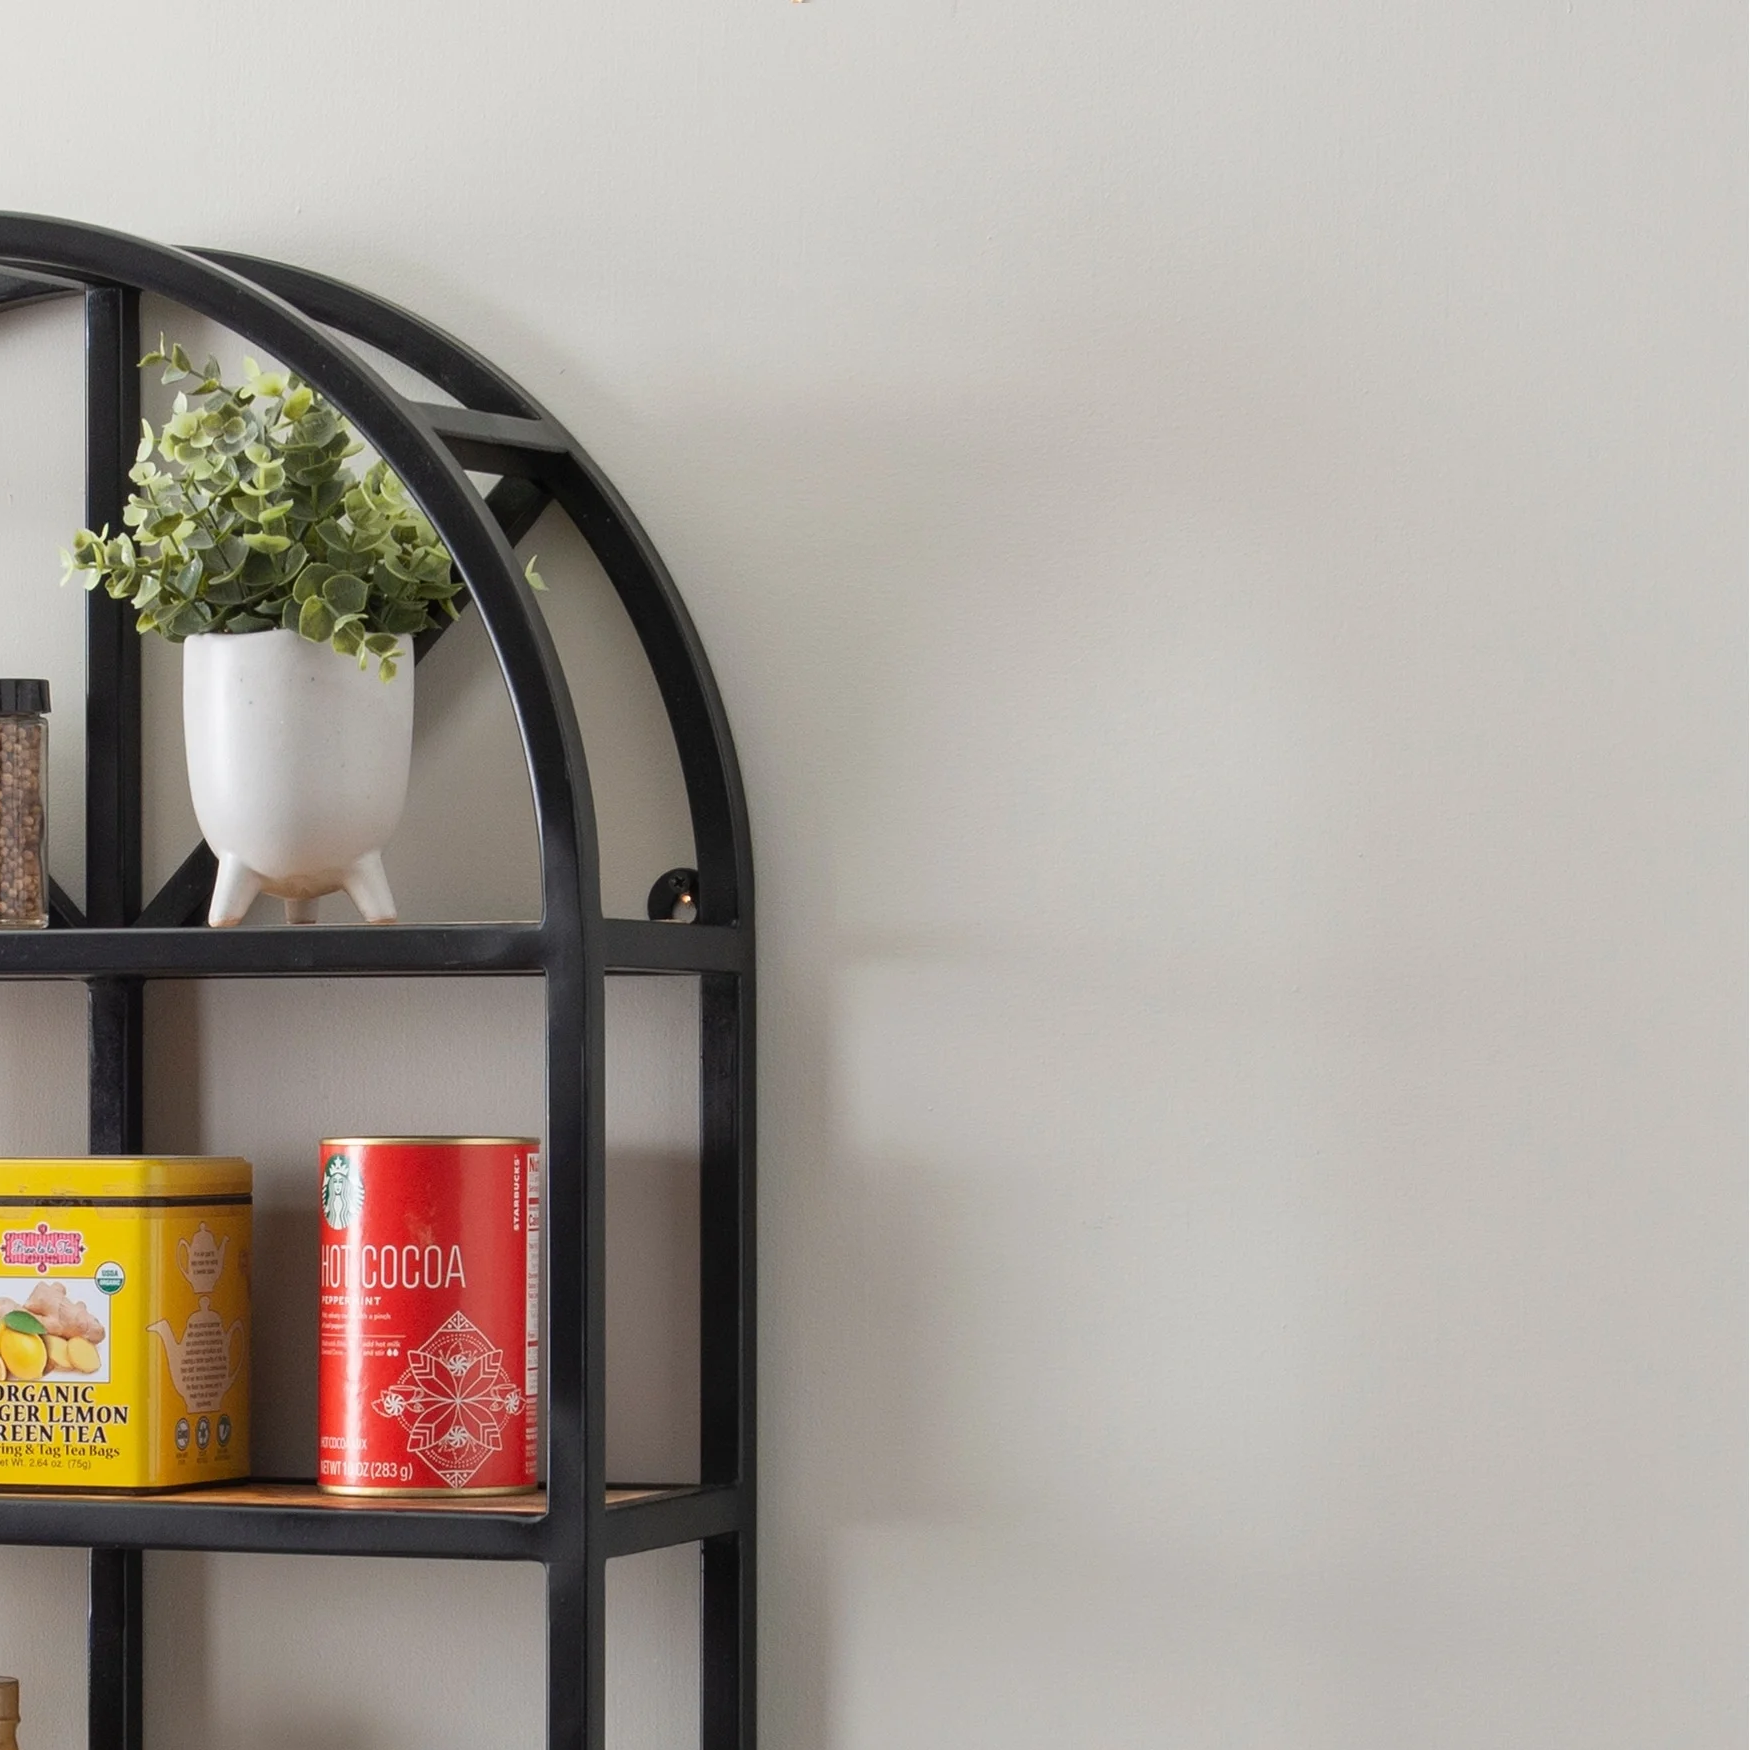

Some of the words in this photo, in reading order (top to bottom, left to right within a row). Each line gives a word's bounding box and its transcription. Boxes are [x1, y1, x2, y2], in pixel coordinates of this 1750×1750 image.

[321, 1244, 350, 1288] HOT
[362, 1244, 467, 1289] COCOA
[321, 1295, 382, 1306] PEPPERINT
[48, 1405, 129, 1424] LEMON
[61, 1425, 107, 1443] TEA
[25, 1444, 35, 1455] &
[36, 1444, 61, 1458] Tag
[64, 1445, 86, 1457] Tea
[89, 1445, 120, 1458] Bags
[11, 1458, 25, 1467] Wt.
[29, 1458, 48, 1467] 2.64
[67, 1459, 92, 1470] (75g)
[370, 1461, 397, 1480] (283
[400, 1462, 413, 1482] g)
